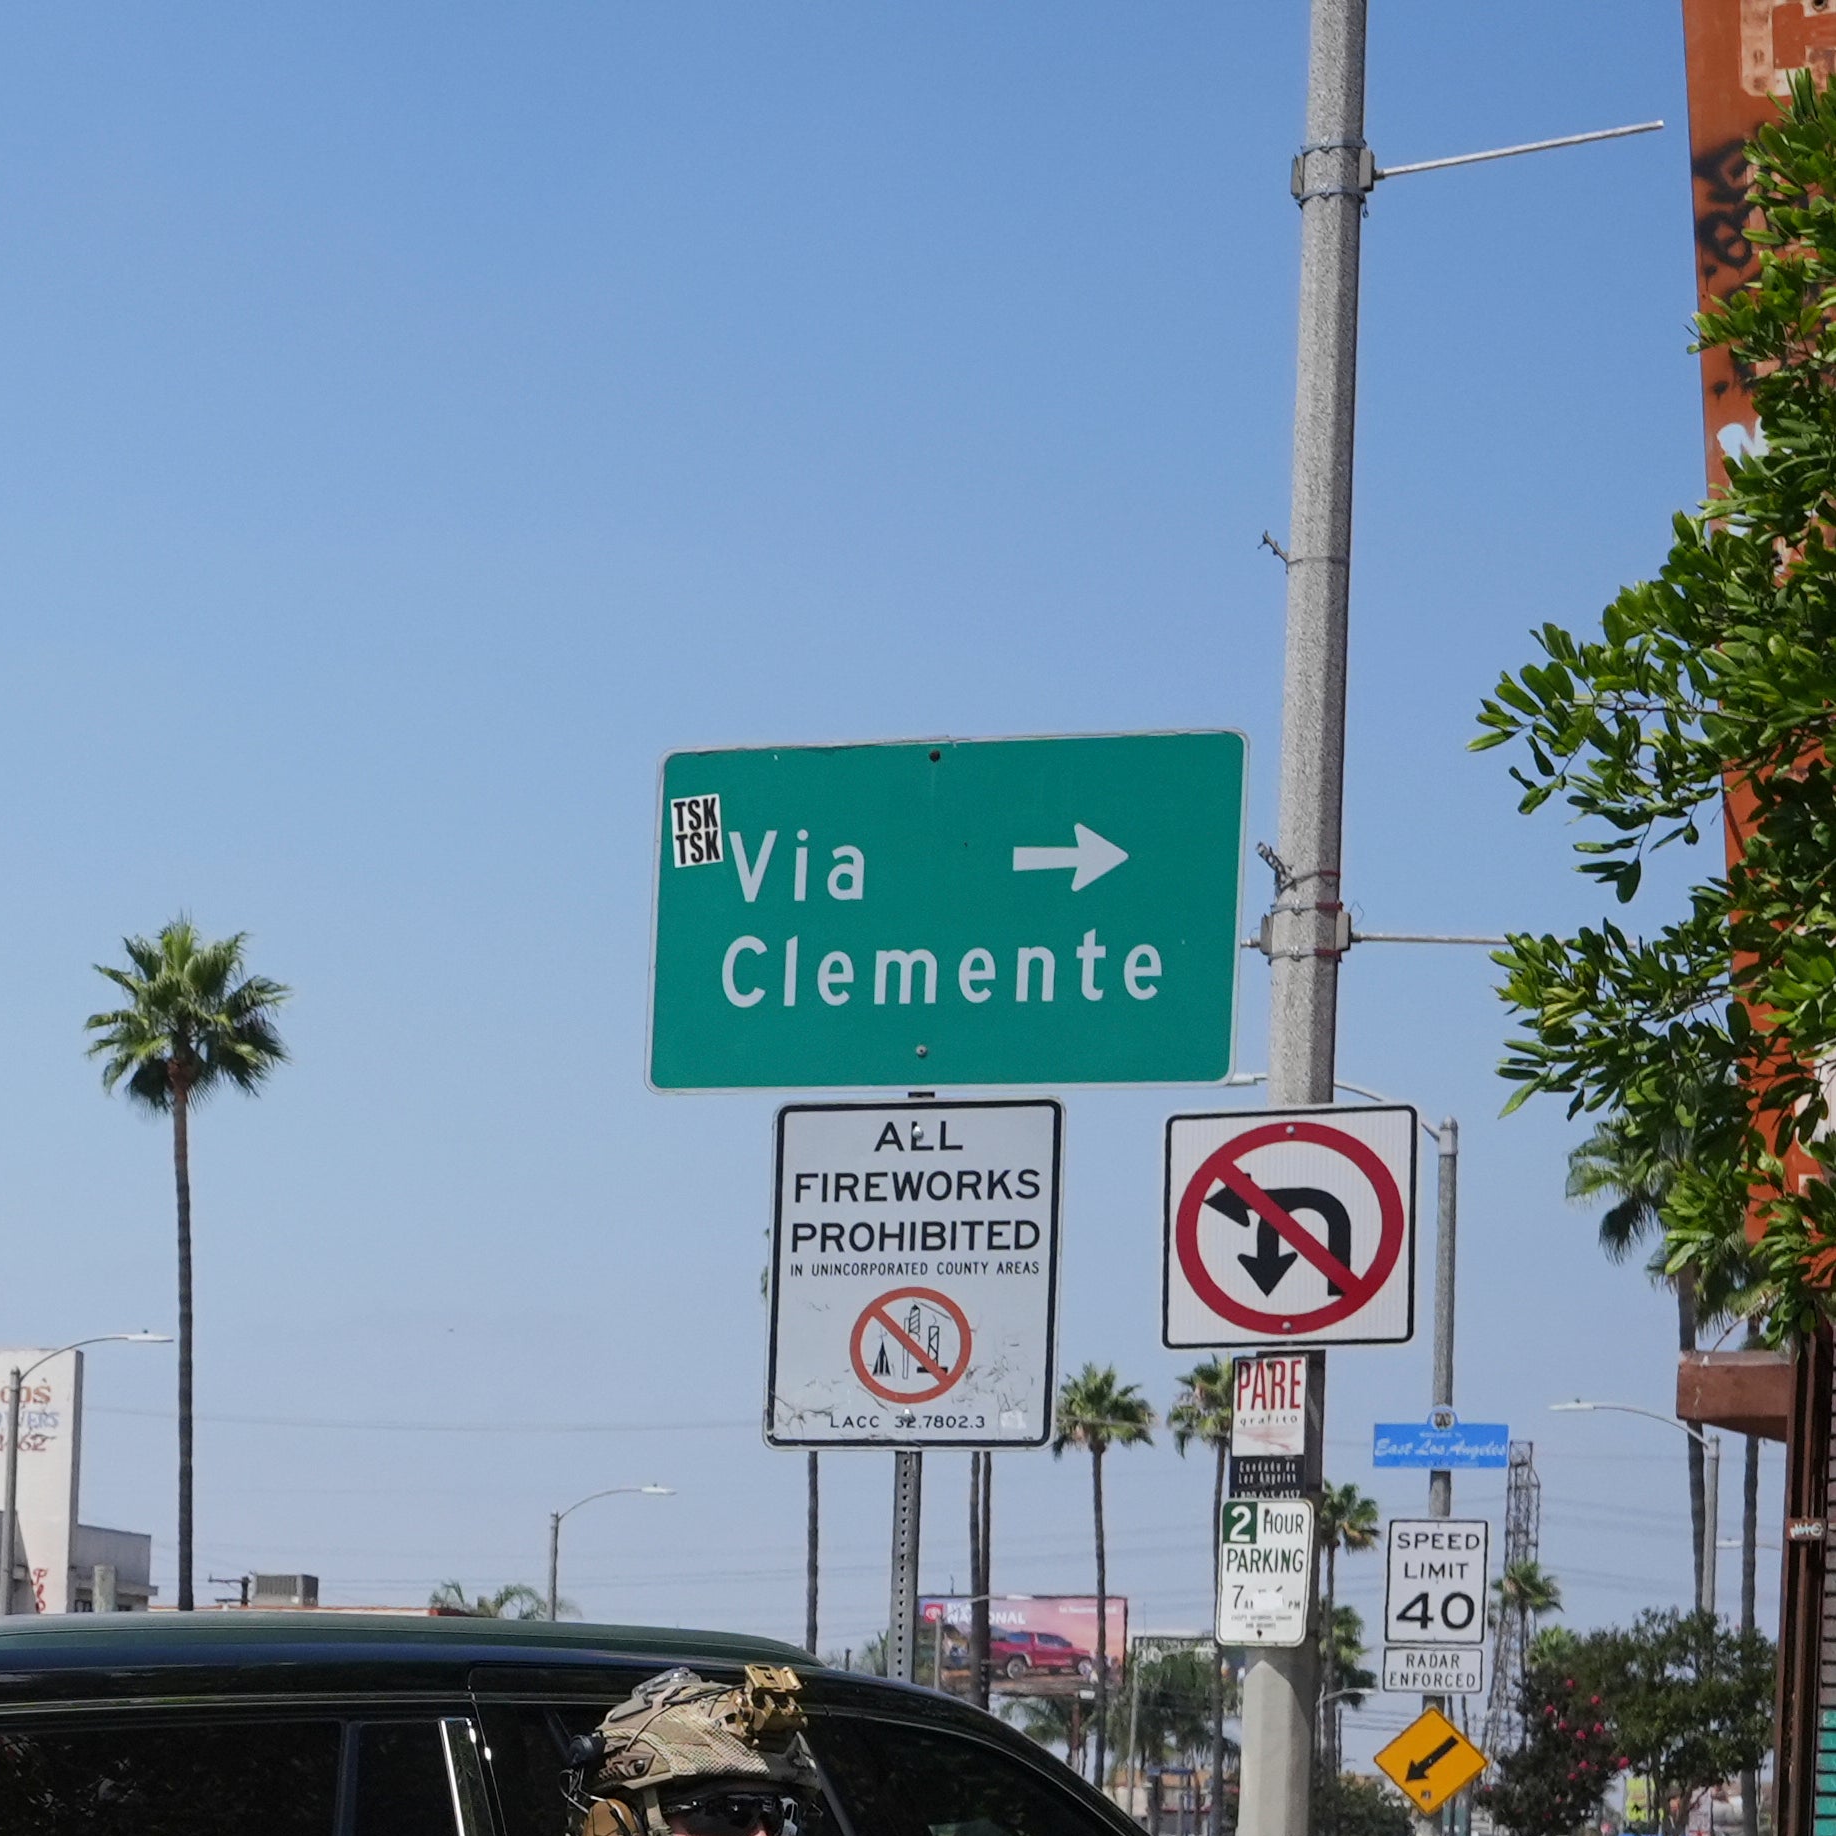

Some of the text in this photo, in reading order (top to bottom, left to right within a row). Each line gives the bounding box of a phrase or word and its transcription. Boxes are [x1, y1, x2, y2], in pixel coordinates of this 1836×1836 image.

[674, 797, 718, 832] TSK
[675, 829, 721, 865] TSK
[728, 829, 865, 903] Via
[721, 928, 1163, 1009] Clemente
[874, 1120, 963, 1152] ALL
[794, 1168, 1041, 1203] FIREWORKS
[791, 1219, 1041, 1253] PROHIBITED
[790, 1261, 1040, 1277] IN UNINCORPORATED COUNTY AREAS
[1237, 1359, 1302, 1412] PARE
[830, 1415, 986, 1429] LACC 32.7802.3
[1240, 1414, 1298, 1427] grafito
[1374, 1437, 1414, 1457] East
[1415, 1438, 1446, 1456] Los
[1229, 1504, 1304, 1543] 2 HOUR
[1397, 1532, 1480, 1551] SPEED
[1227, 1548, 1305, 1574] PARKING
[1404, 1561, 1470, 1580] LIMIT
[1232, 1584, 1245, 1610] 7
[1396, 1591, 1475, 1630] 40
[1405, 1653, 1460, 1669] RADAR
[1389, 1671, 1476, 1689] ENFORCED
